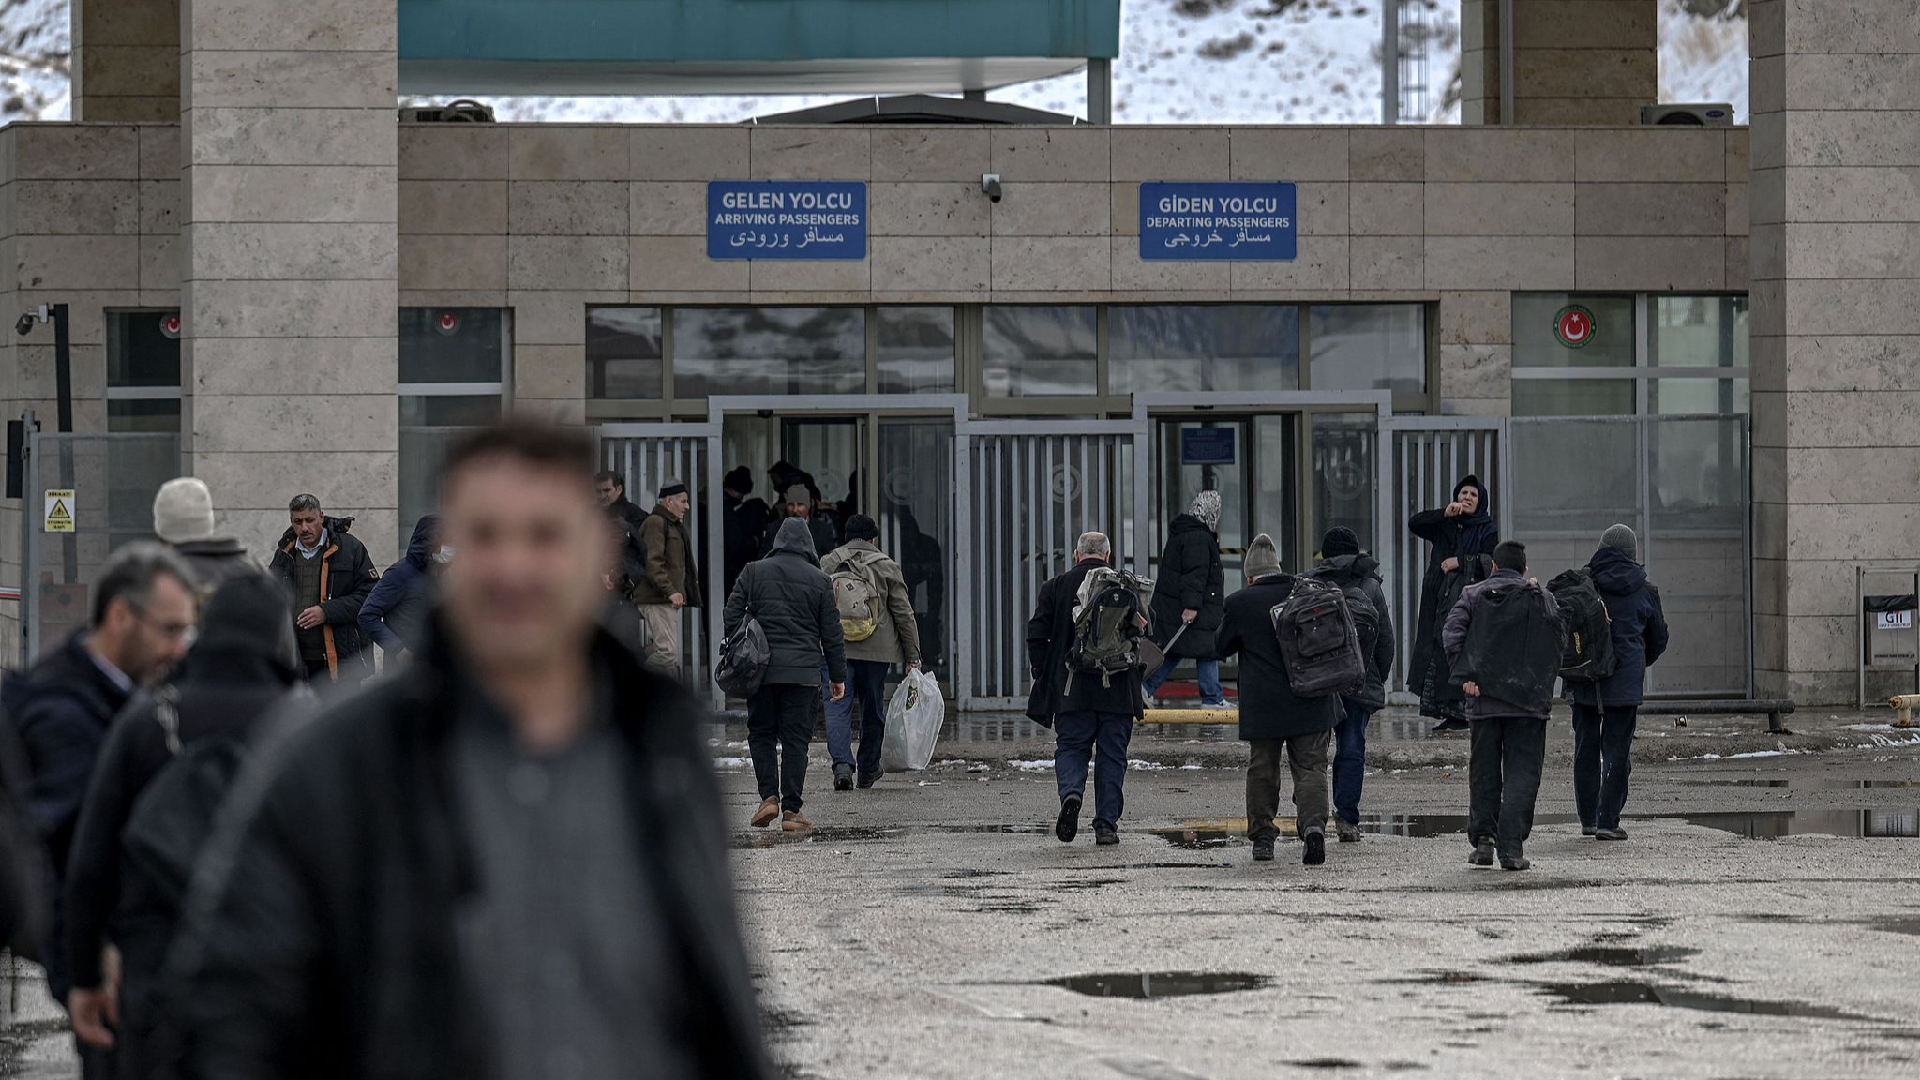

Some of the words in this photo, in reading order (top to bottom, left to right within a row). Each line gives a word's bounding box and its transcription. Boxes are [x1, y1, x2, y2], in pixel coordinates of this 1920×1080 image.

[722, 192, 785, 209] GELEN
[789, 192, 852, 209] YOLCU
[1158, 194, 1214, 213] GİDEN
[1219, 197, 1277, 213] YOLCU
[714, 213, 776, 225] ARRIVING
[779, 213, 860, 225] PASSENGERS
[1146, 217, 1212, 228] DEPARTING
[1215, 217, 1290, 228] PASSENGERS
[796, 226, 844, 248] مسافر
[1228, 227, 1271, 248] مسافر
